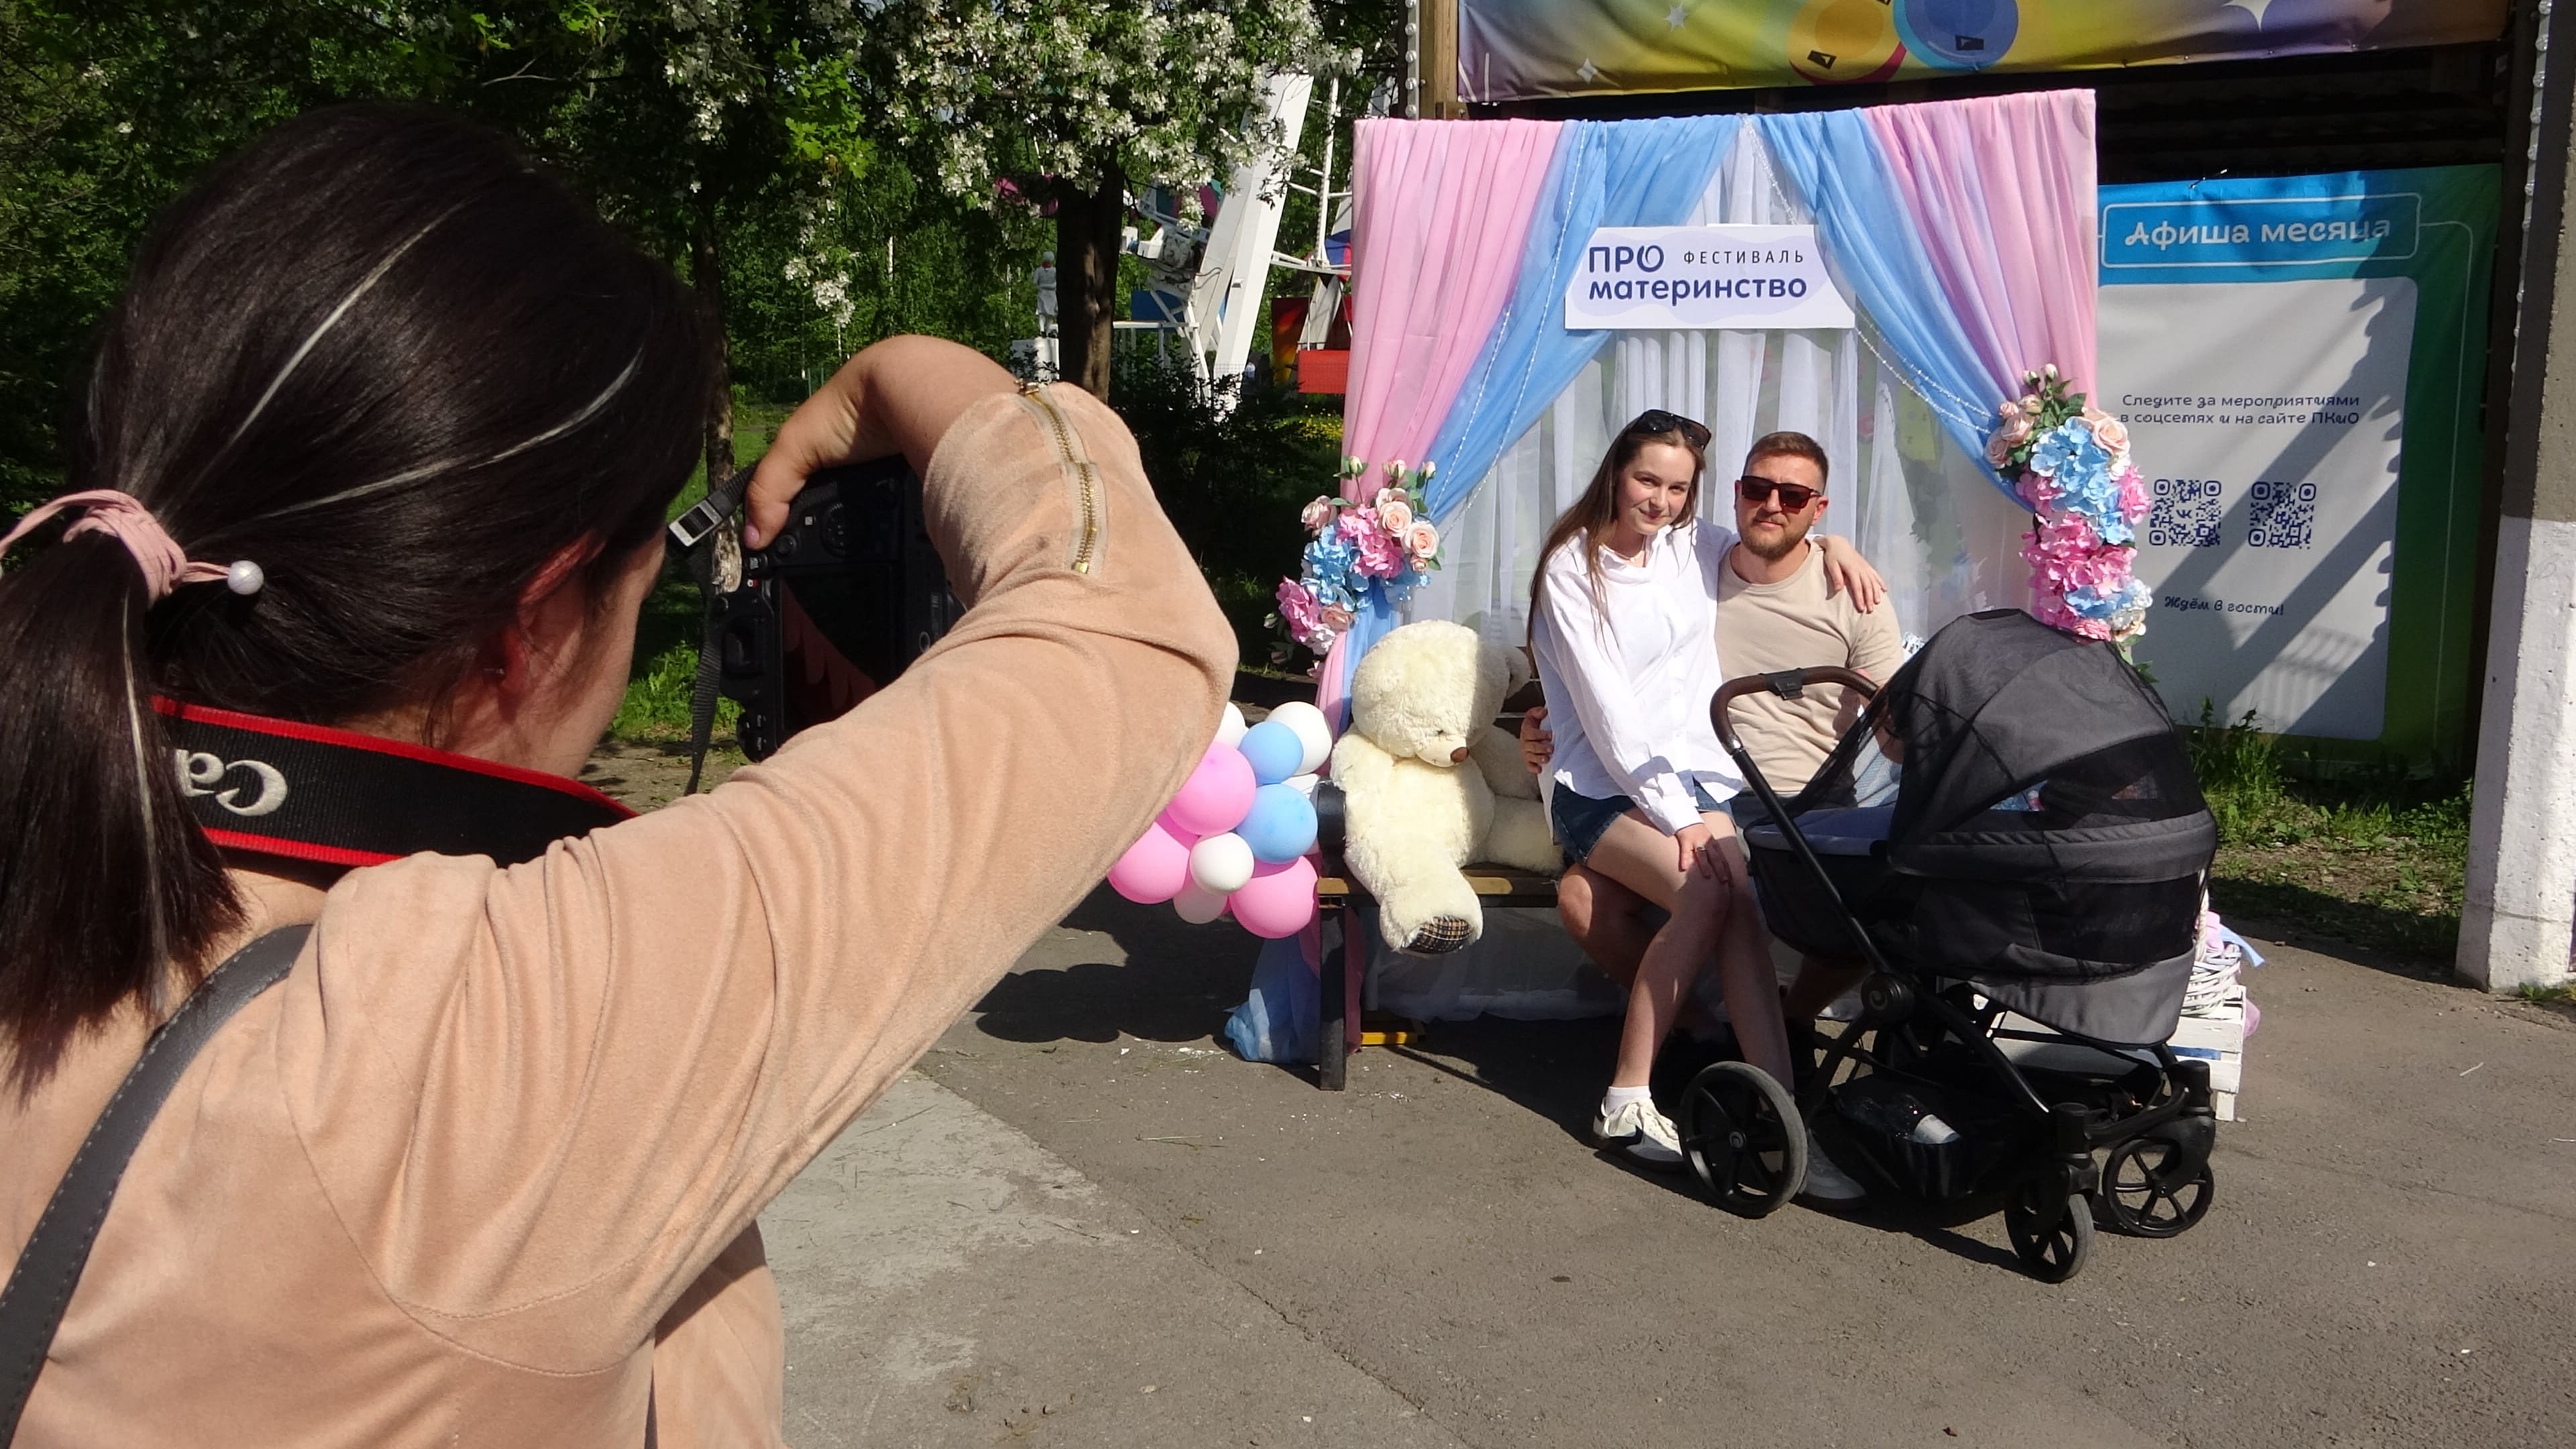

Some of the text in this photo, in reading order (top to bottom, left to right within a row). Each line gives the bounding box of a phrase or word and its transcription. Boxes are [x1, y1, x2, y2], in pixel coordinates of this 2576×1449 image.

[2125, 219, 2390, 251] Афиша месяца
[1589, 245, 1664, 274] ПРО
[1683, 250, 1804, 265] ФЕСТИВАЛЬ
[1589, 278, 1807, 307] материнство
[2122, 394, 2360, 409] Следите за мероприятиями
[2120, 411, 2359, 425] в соцсетях и на сайте ПКиО
[2164, 596, 2284, 616] Ждём в гости!
